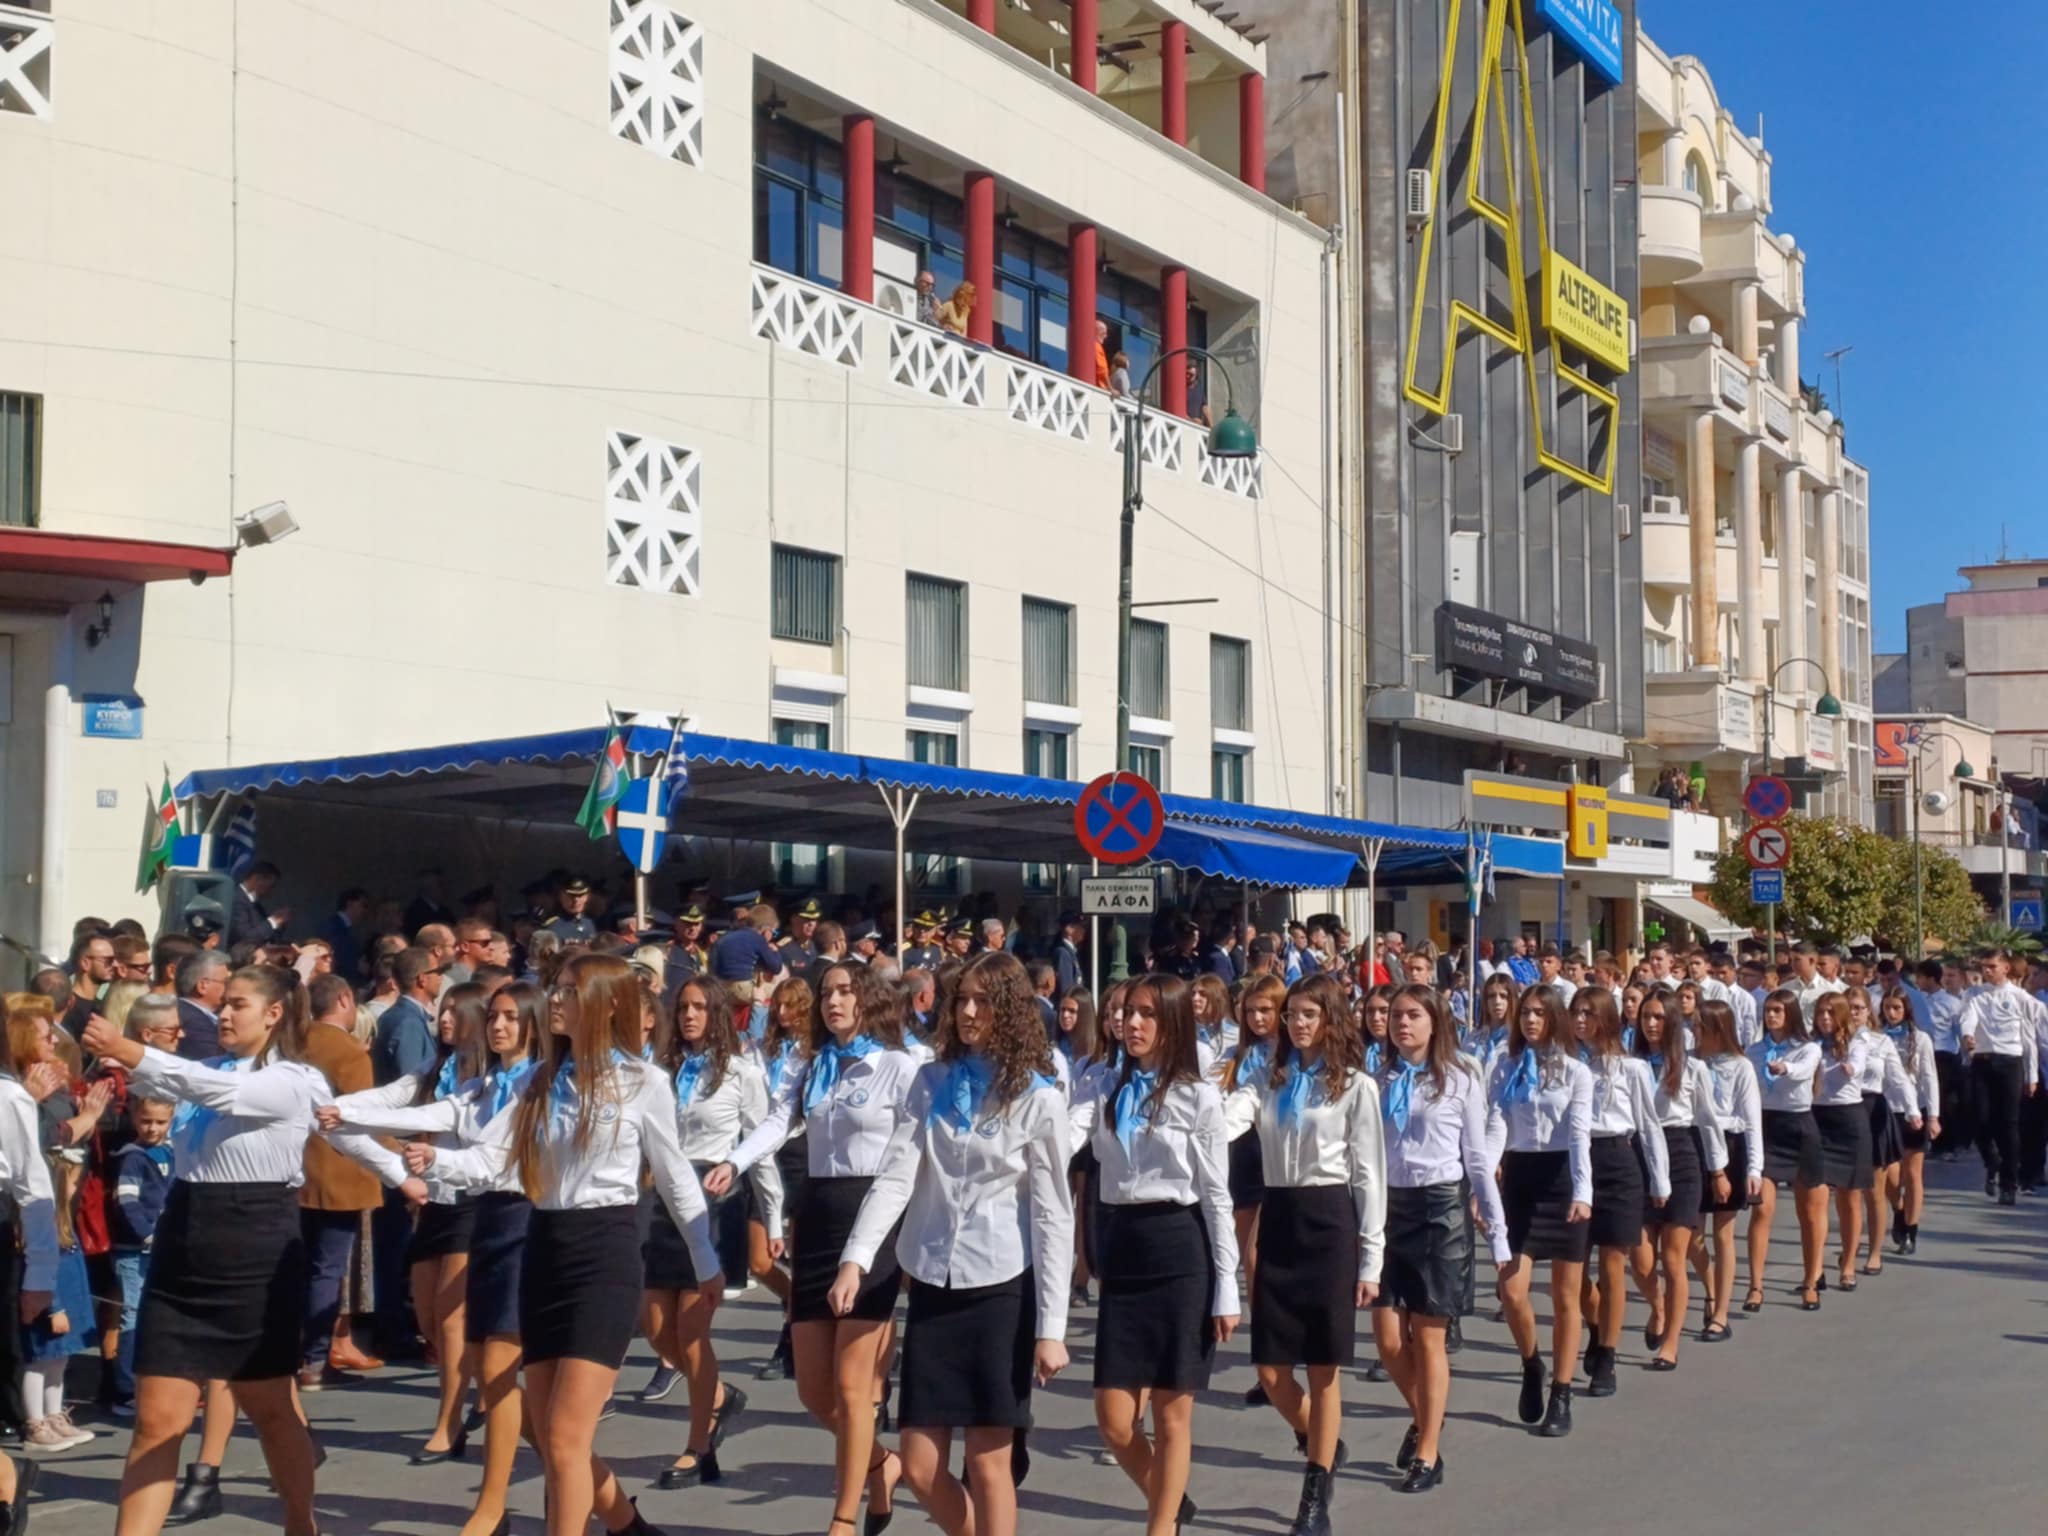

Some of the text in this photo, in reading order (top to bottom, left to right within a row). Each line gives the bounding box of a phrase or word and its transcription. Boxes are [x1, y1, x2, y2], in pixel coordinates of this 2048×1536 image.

[1558, 270, 1623, 338] ALTERLIFE
[1558, 307, 1623, 357] FITNESS EXCELLENCE
